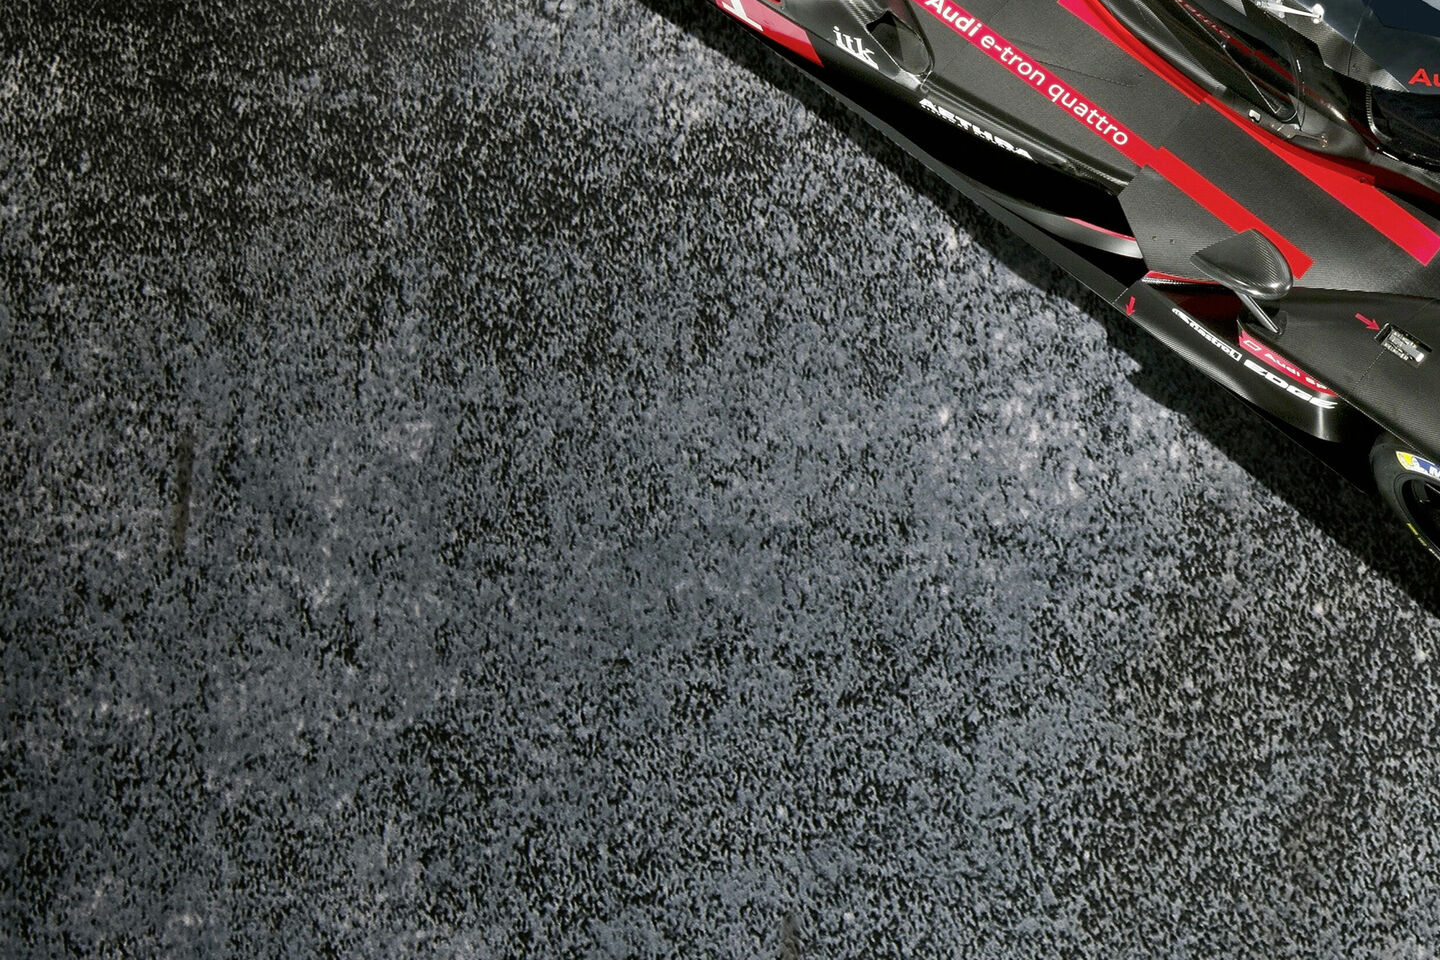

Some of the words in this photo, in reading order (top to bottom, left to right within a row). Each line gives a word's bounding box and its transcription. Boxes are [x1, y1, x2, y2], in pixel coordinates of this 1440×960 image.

[980, 34, 1046, 86] e-tron
[1048, 84, 1129, 146] quattro
[1243, 358, 1339, 409] EDGE
